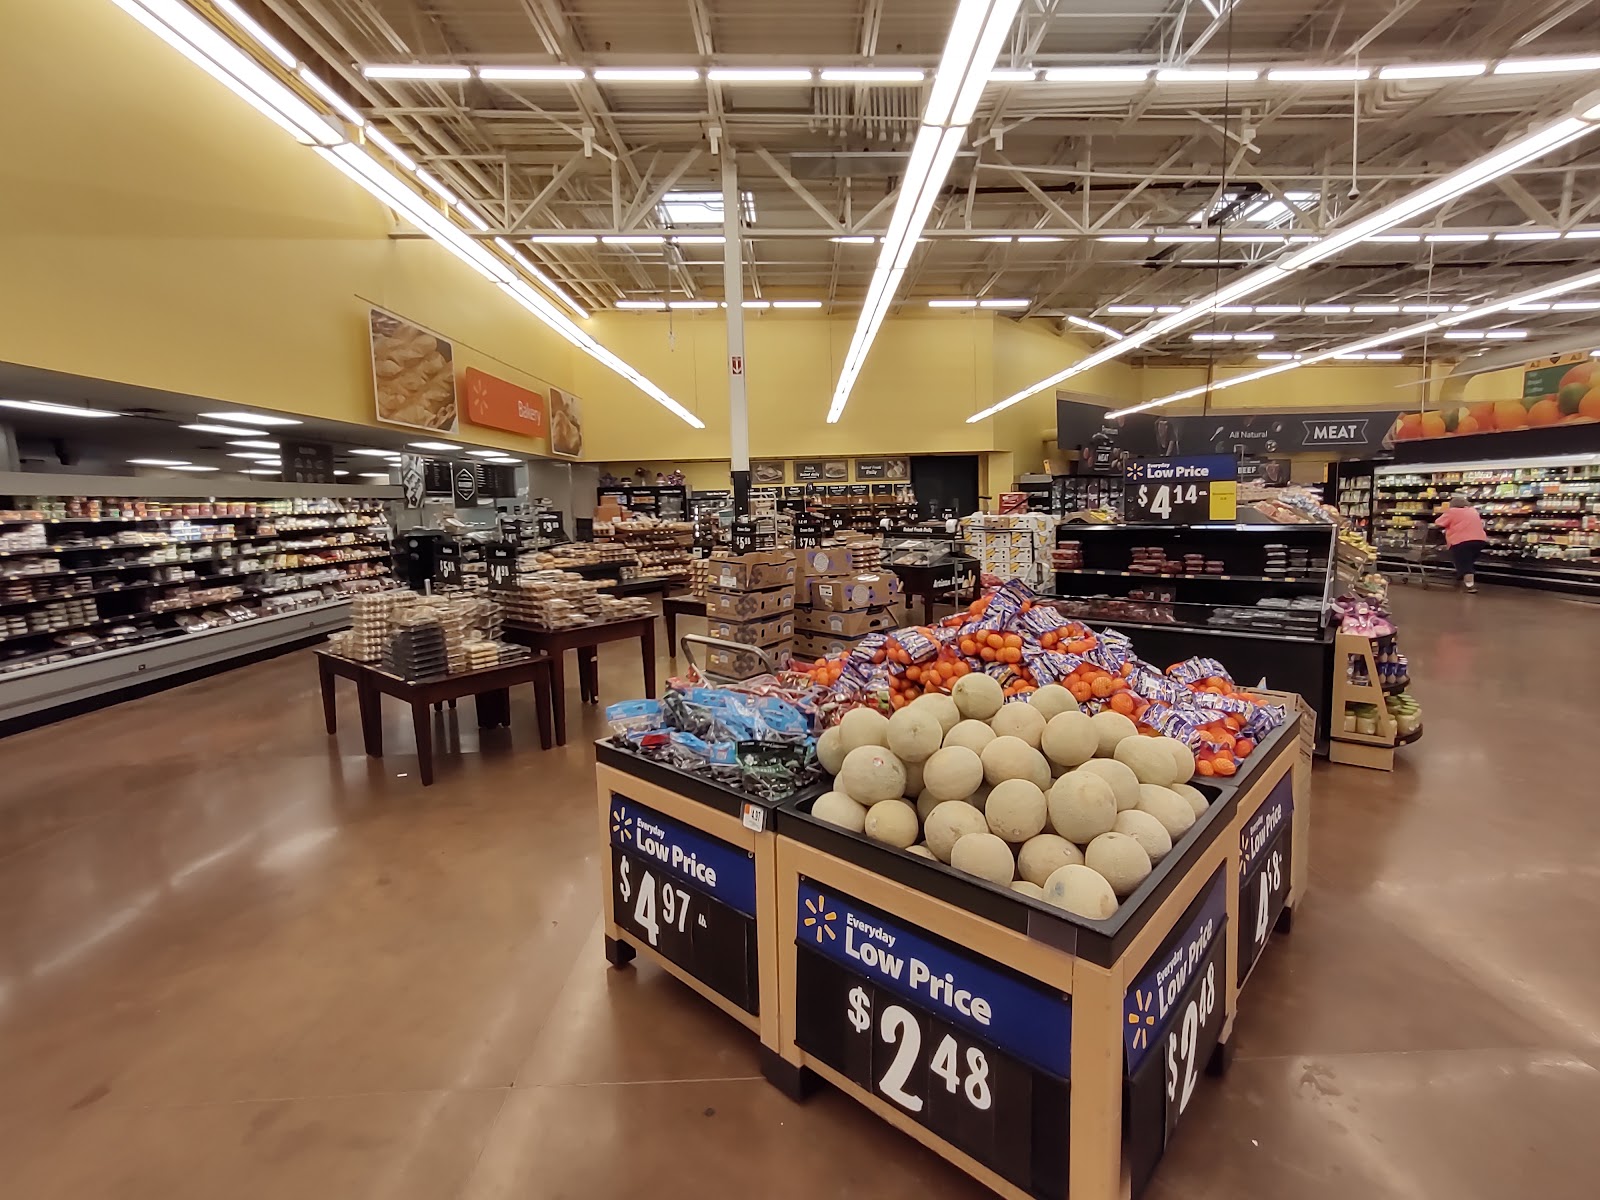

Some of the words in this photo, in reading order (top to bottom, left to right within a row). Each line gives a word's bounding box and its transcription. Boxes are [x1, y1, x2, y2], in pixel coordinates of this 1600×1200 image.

[517, 400, 542, 427] Bakery
[1229, 430, 1240, 439] All
[1241, 430, 1268, 439] Natural
[1313, 424, 1358, 440] MEAT
[1146, 467, 1174, 479] Low
[1175, 465, 1210, 478] Price
[637, 817, 665, 840] Everyday
[1250, 831, 1266, 860] Low
[1265, 803, 1282, 836] Price
[636, 827, 670, 863] Low
[672, 844, 717, 888] Price
[846, 912, 897, 948] Everyday
[845, 925, 904, 980] Low
[909, 957, 992, 1026] Price
[1156, 946, 1184, 986] Everyday
[1158, 960, 1187, 1020] Low
[1187, 918, 1213, 975] Price
